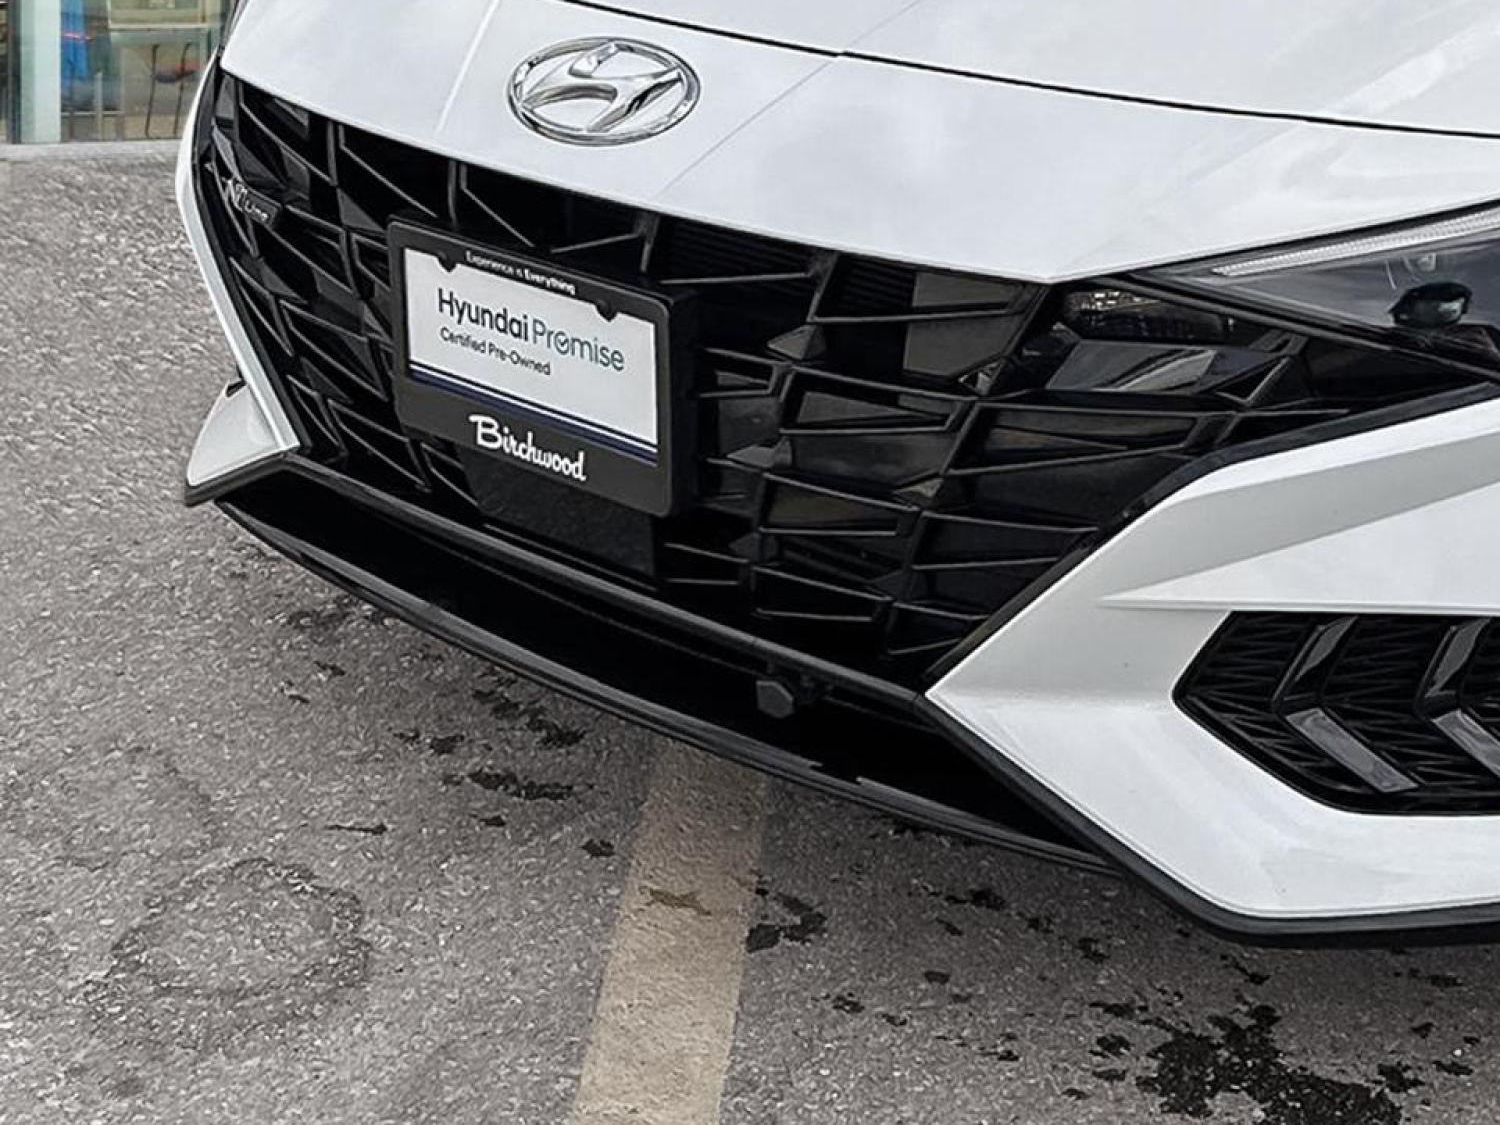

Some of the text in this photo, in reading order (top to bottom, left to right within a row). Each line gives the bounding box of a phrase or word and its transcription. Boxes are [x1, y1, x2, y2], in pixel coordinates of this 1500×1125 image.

[524, 268, 576, 296] Everything
[438, 288, 625, 372] Hyundai Promise
[440, 326, 551, 376] Certified Pre-Owned
[468, 414, 587, 482] Birchwood
